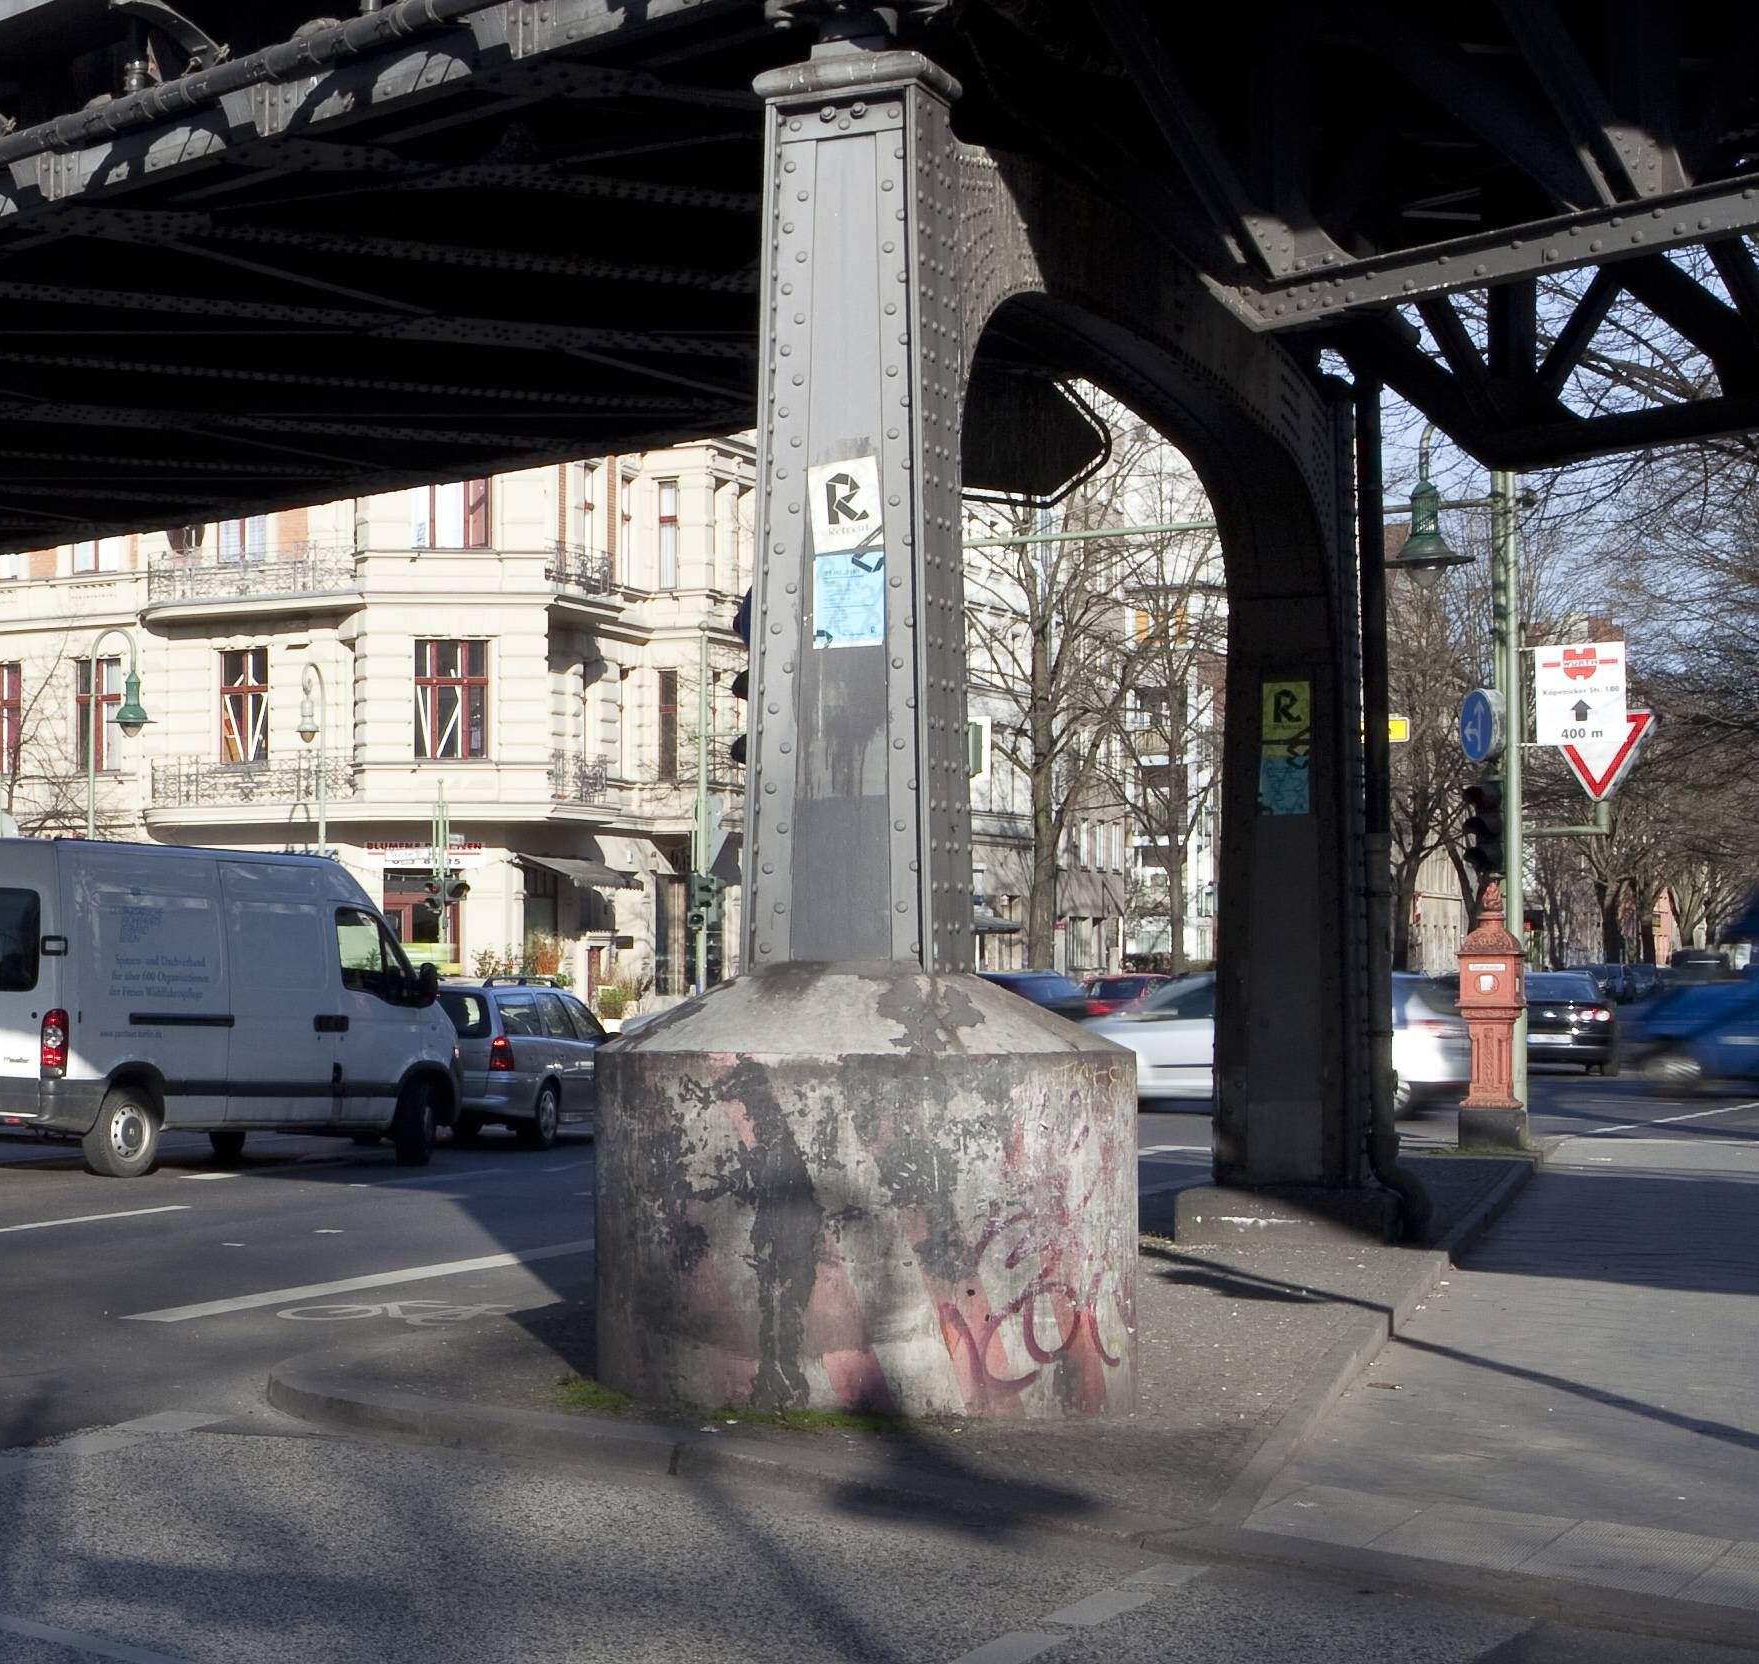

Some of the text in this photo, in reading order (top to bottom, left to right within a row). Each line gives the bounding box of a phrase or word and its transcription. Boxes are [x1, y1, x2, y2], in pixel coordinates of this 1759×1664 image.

[826, 472, 870, 525] R
[1272, 689, 1303, 723] R
[1561, 728, 1587, 739] 400
